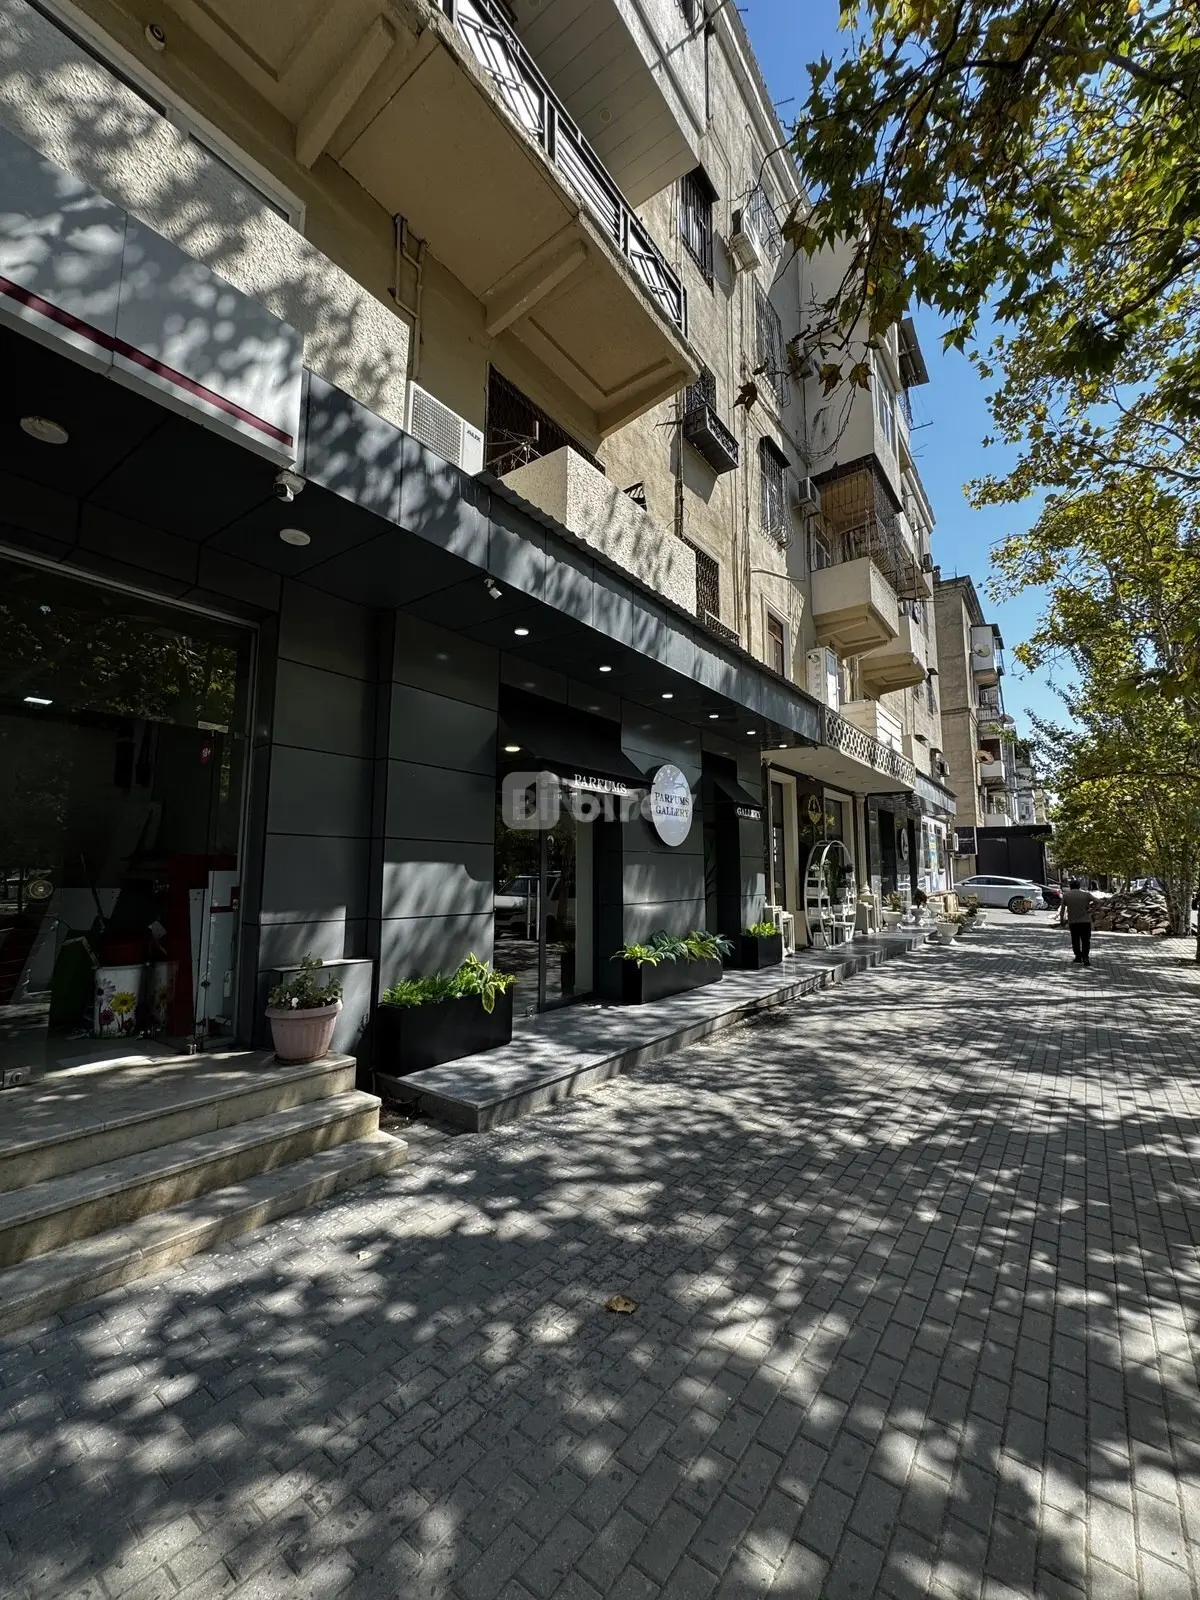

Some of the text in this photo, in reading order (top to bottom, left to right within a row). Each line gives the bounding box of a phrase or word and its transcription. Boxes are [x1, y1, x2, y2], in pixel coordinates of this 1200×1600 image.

[574, 773, 627, 793] PARFUMS
[655, 792, 690, 806] PARFUMS
[655, 805, 689, 818] GALLERY
